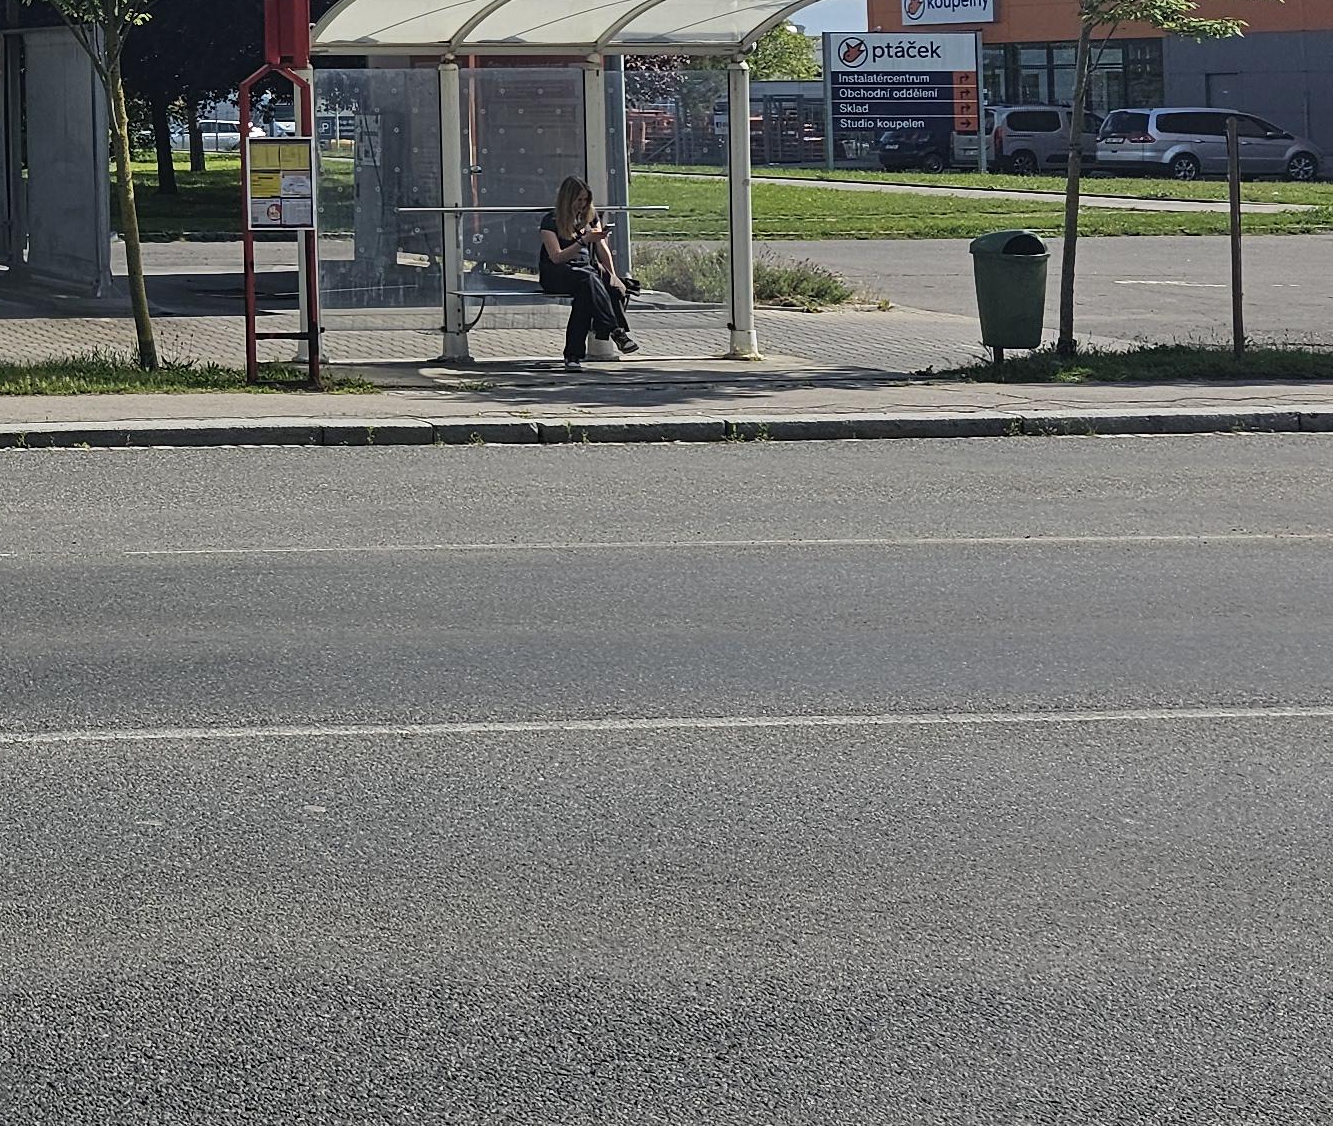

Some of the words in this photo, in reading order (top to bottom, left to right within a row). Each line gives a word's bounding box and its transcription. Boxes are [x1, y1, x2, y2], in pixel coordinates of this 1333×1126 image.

[872, 40, 941, 63] ptáček
[838, 73, 930, 83] Instalatércentrum
[839, 88, 890, 98] Obchodní
[893, 88, 938, 98] oddělení
[839, 103, 869, 113] Sklad
[840, 118, 874, 128] Studio
[876, 119, 925, 130] koupelen
